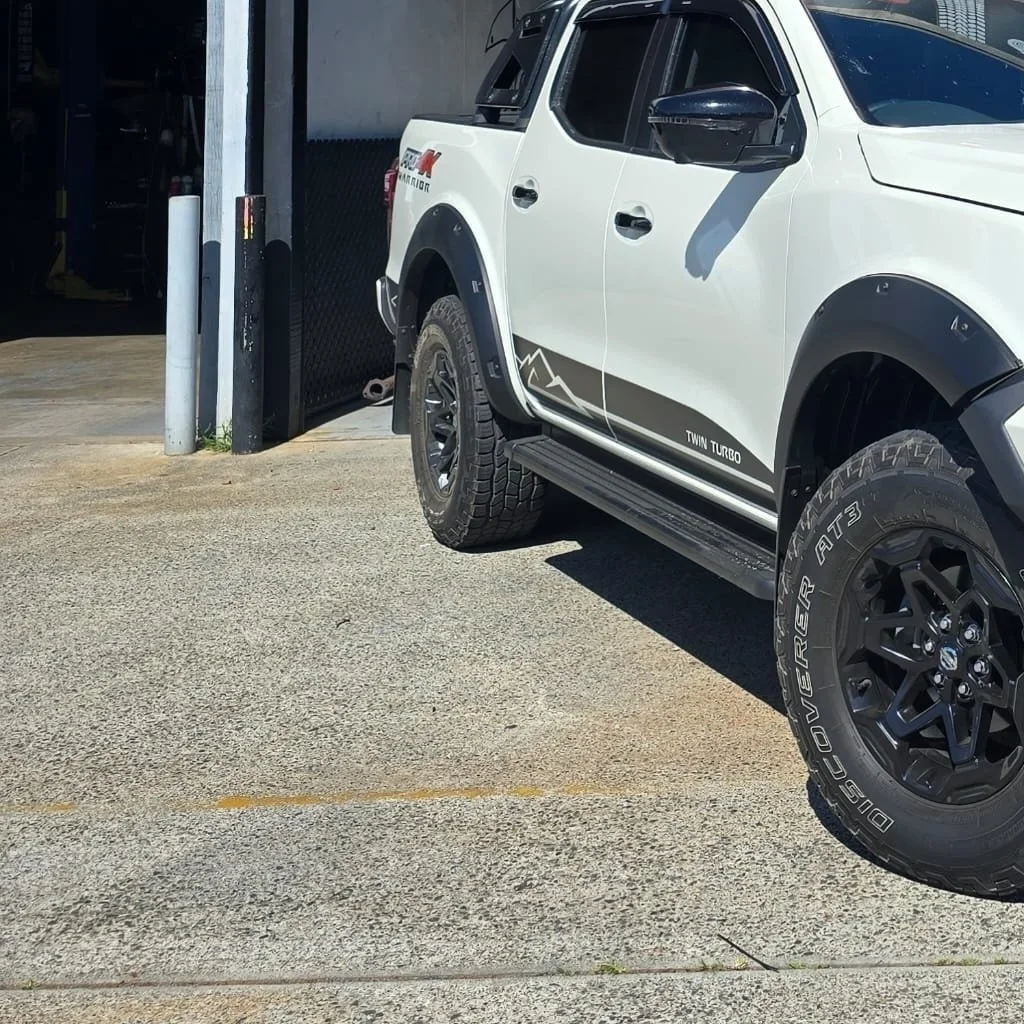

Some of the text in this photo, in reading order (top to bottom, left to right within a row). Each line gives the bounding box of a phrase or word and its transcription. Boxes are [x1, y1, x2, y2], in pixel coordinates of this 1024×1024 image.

[685, 430, 741, 465] TWIN TURBO
[794, 501, 895, 833] DISCOVERER AT3
